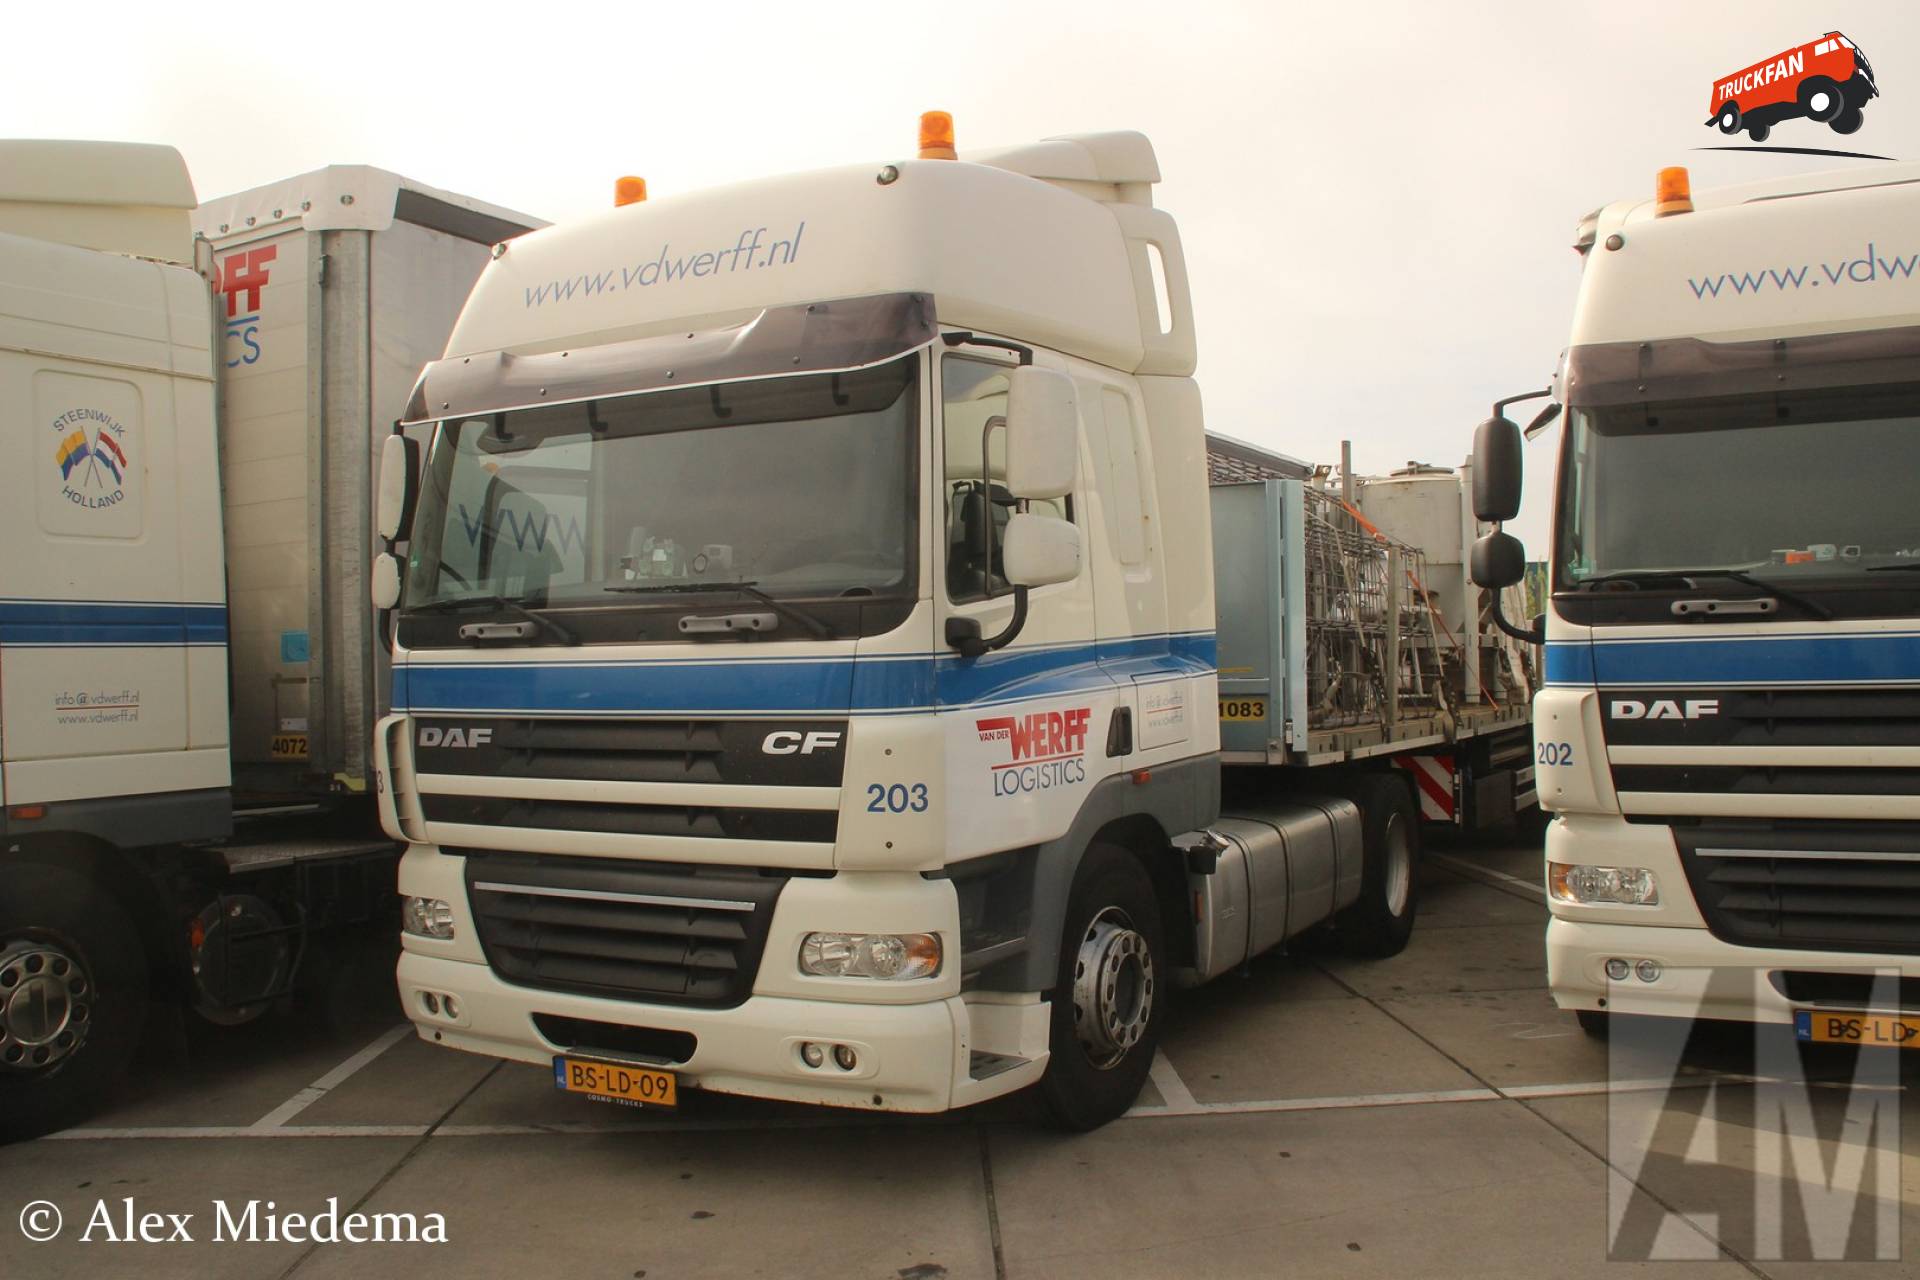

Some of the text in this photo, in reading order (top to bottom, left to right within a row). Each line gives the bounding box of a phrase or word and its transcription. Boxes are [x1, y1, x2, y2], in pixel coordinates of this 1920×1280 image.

[523, 220, 806, 310] www.vdwerff.nl
[213, 244, 277, 318] FF
[53, 407, 126, 438] STEENWIJK
[61, 484, 125, 509] HOLLAND
[1219, 702, 1265, 718] 1083
[1611, 700, 1719, 720] DAF
[272, 738, 307, 755] 4072
[419, 727, 493, 749] DAF
[761, 730, 841, 755] CF
[979, 708, 1091, 761] VAN DER WERFF
[1537, 742, 1574, 767] 202
[993, 758, 1086, 797] LOGISTICS
[866, 783, 930, 814] 203
[572, 1064, 669, 1100] BS-LD-09
